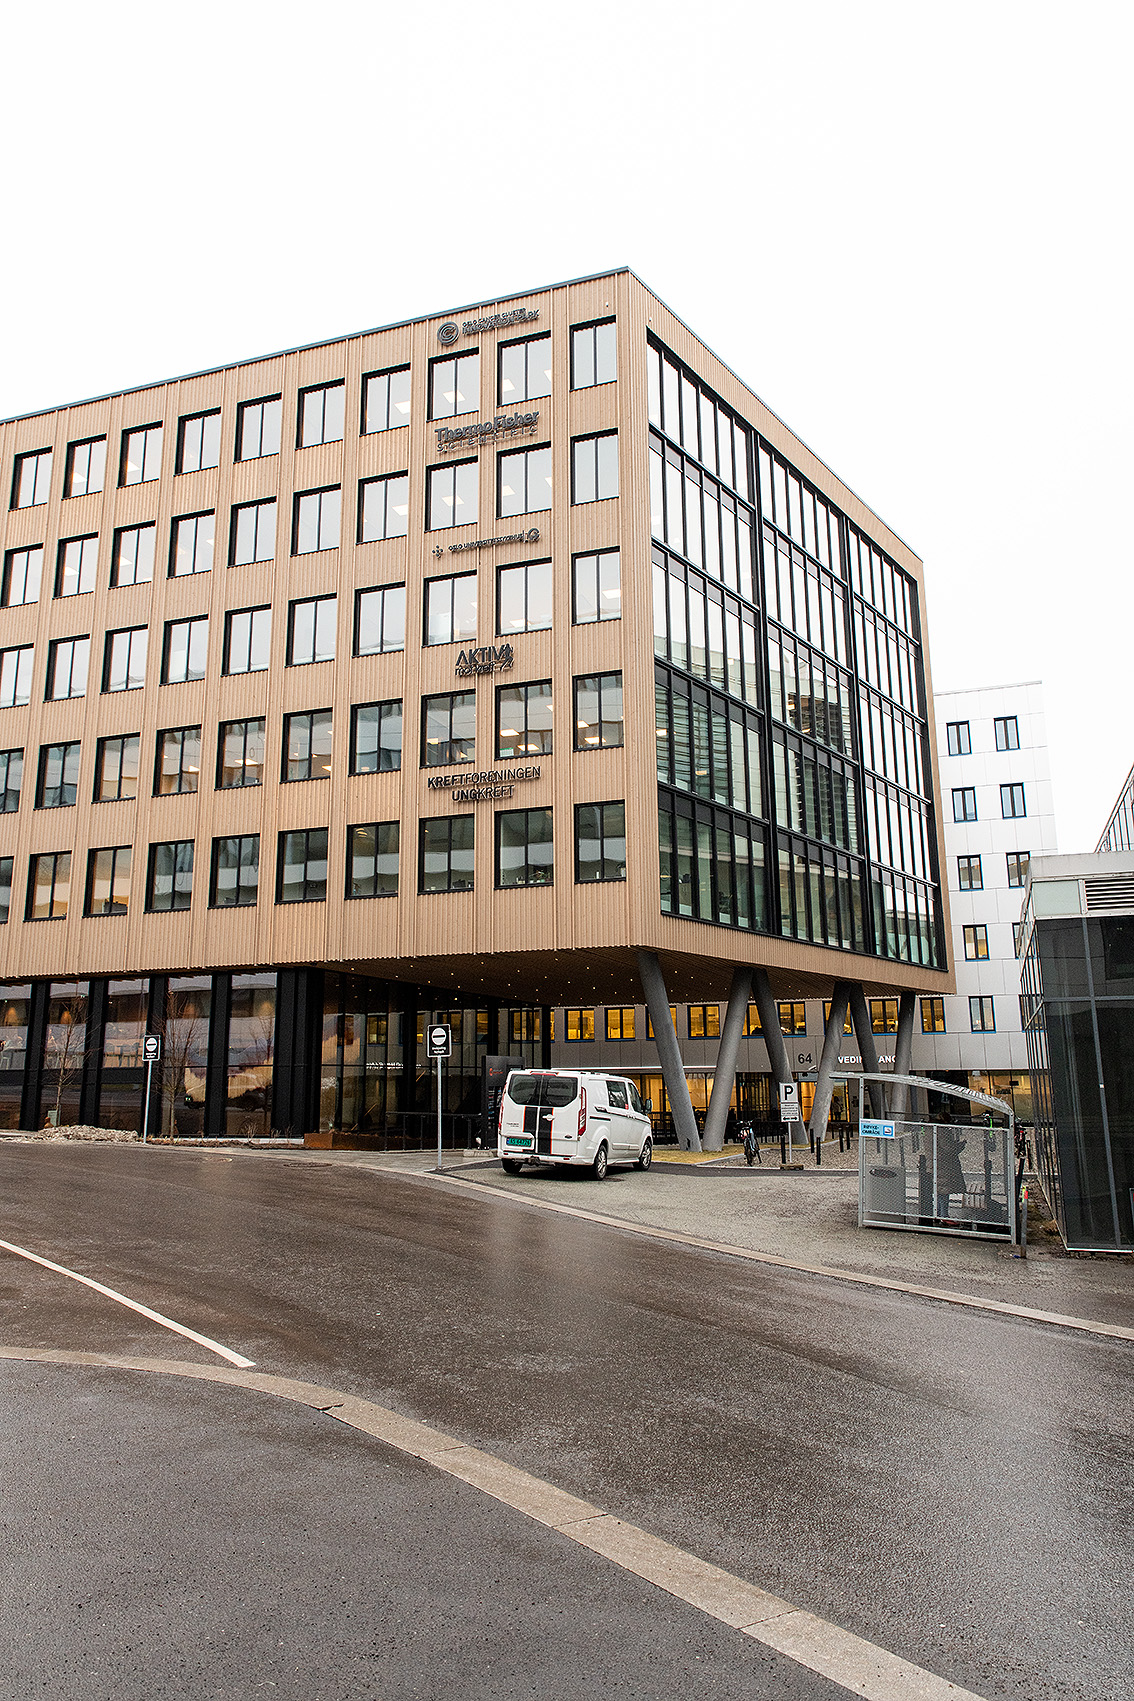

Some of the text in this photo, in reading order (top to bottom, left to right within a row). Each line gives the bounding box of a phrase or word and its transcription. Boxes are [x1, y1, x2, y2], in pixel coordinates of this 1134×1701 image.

[434, 411, 540, 442] Thermo Fisher
[437, 424, 538, 452] SCIENTIFIC
[455, 644, 506, 666] AKTIV
[427, 766, 541, 788] KREFTFORENINGEN
[452, 785, 515, 801] UNGKREFT
[797, 1053, 813, 1064] 64
[784, 1085, 794, 1101] P
